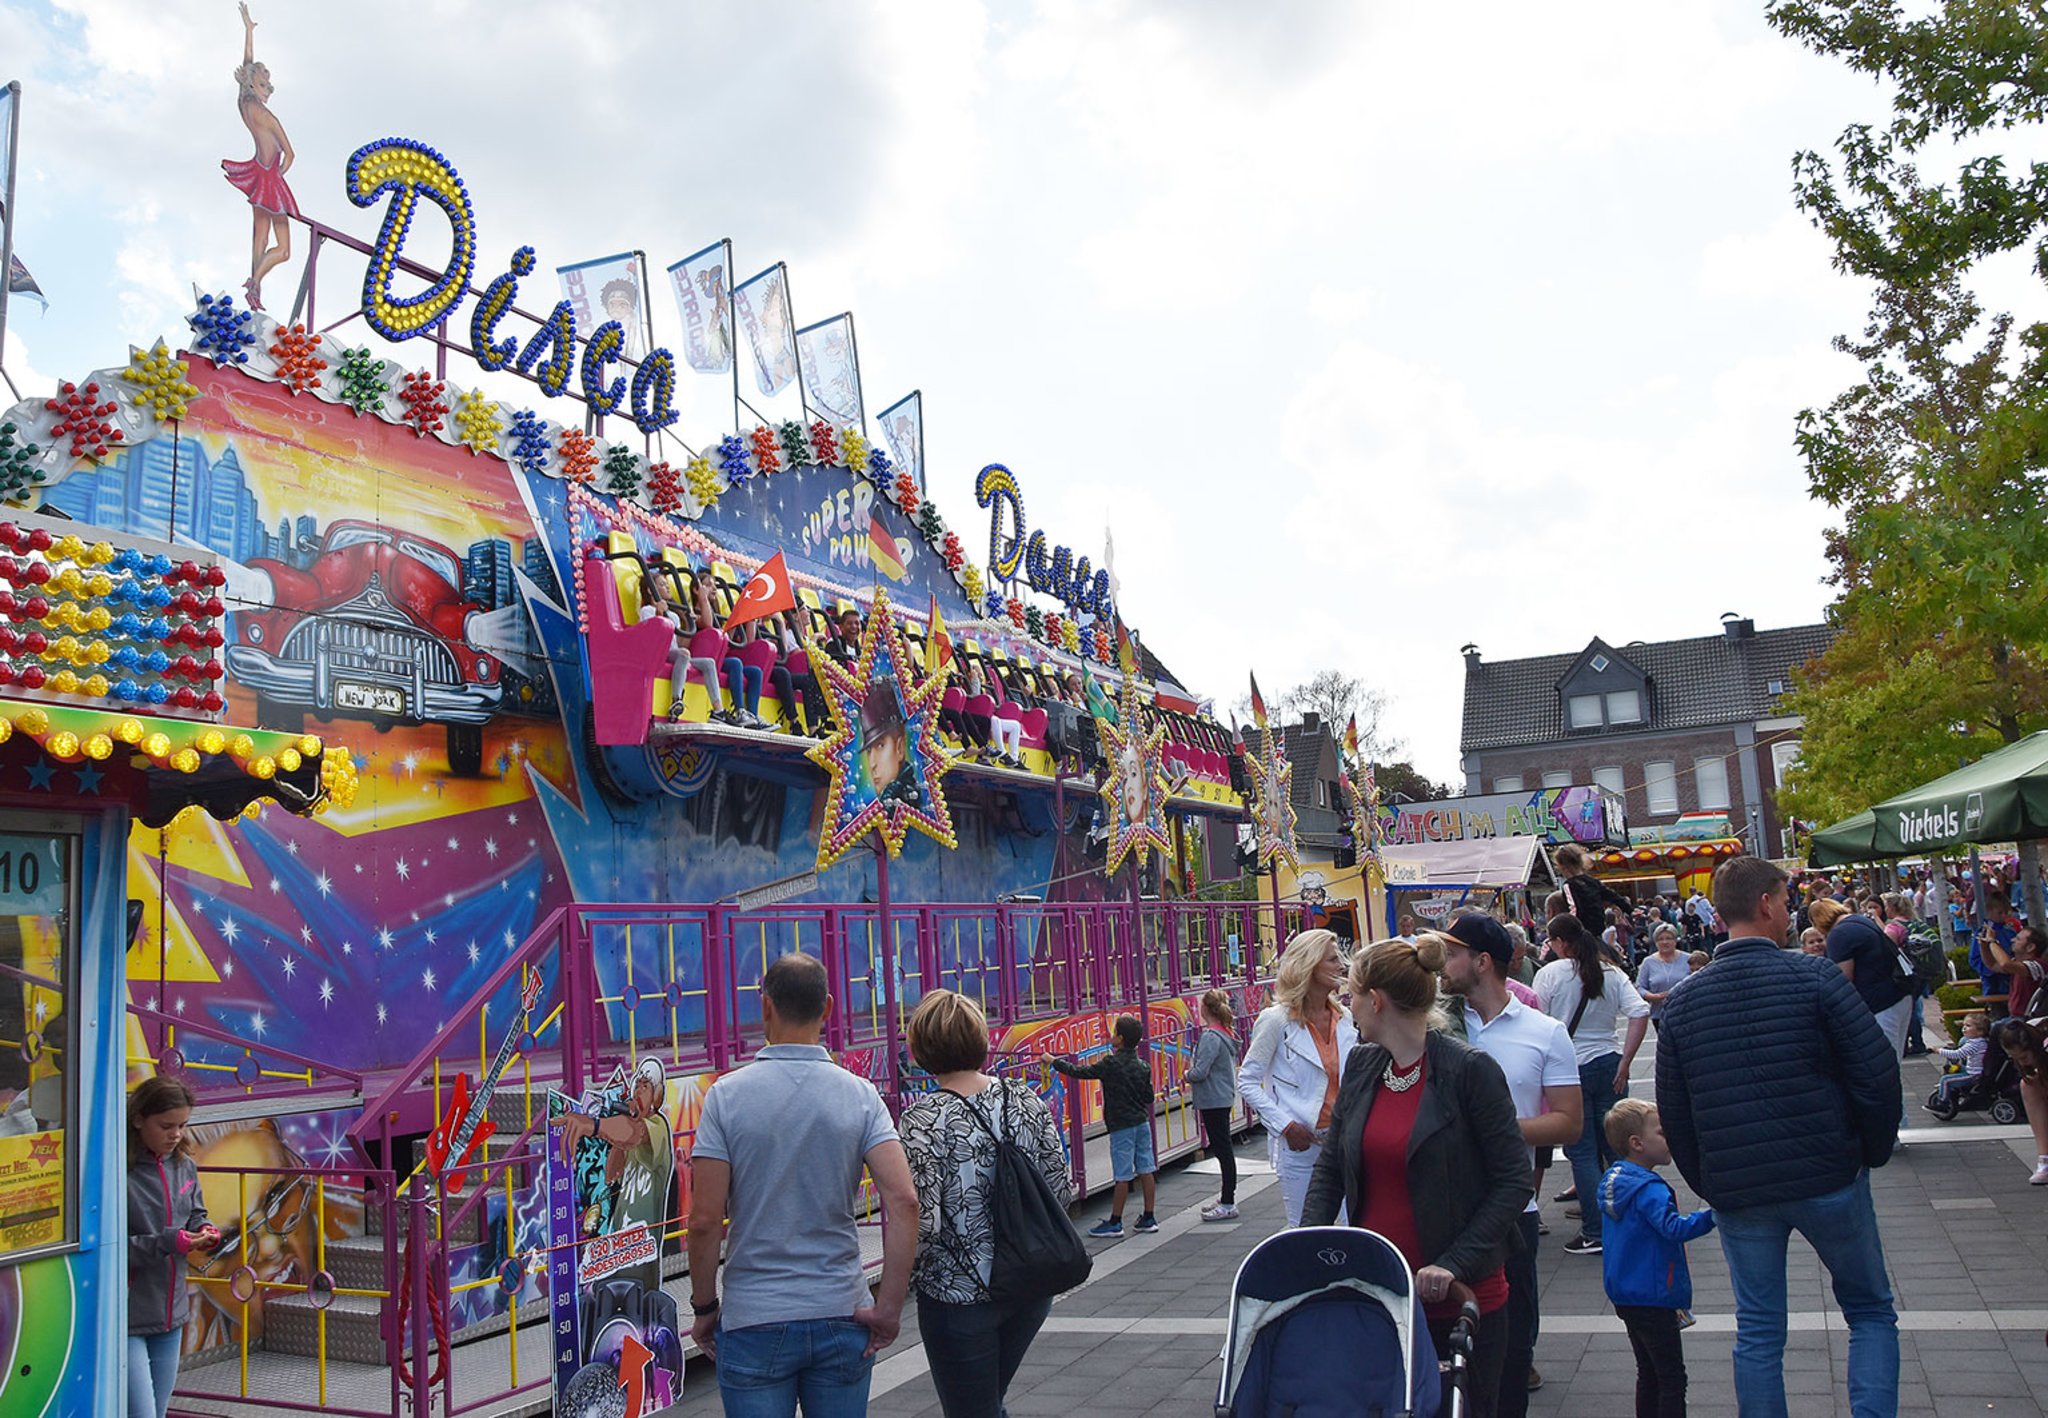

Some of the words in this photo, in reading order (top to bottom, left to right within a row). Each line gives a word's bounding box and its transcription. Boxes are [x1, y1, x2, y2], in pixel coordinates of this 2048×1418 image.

[345, 137, 681, 434] Disco
[802, 480, 875, 558] SUPER
[829, 532, 914, 586] POWR
[345, 690, 366, 706] NEW
[1382, 809, 1462, 846] CATCH
[1504, 796, 1557, 837] ALL
[1039, 1015, 1101, 1055] TAKE
[612, 1229, 646, 1251] METER
